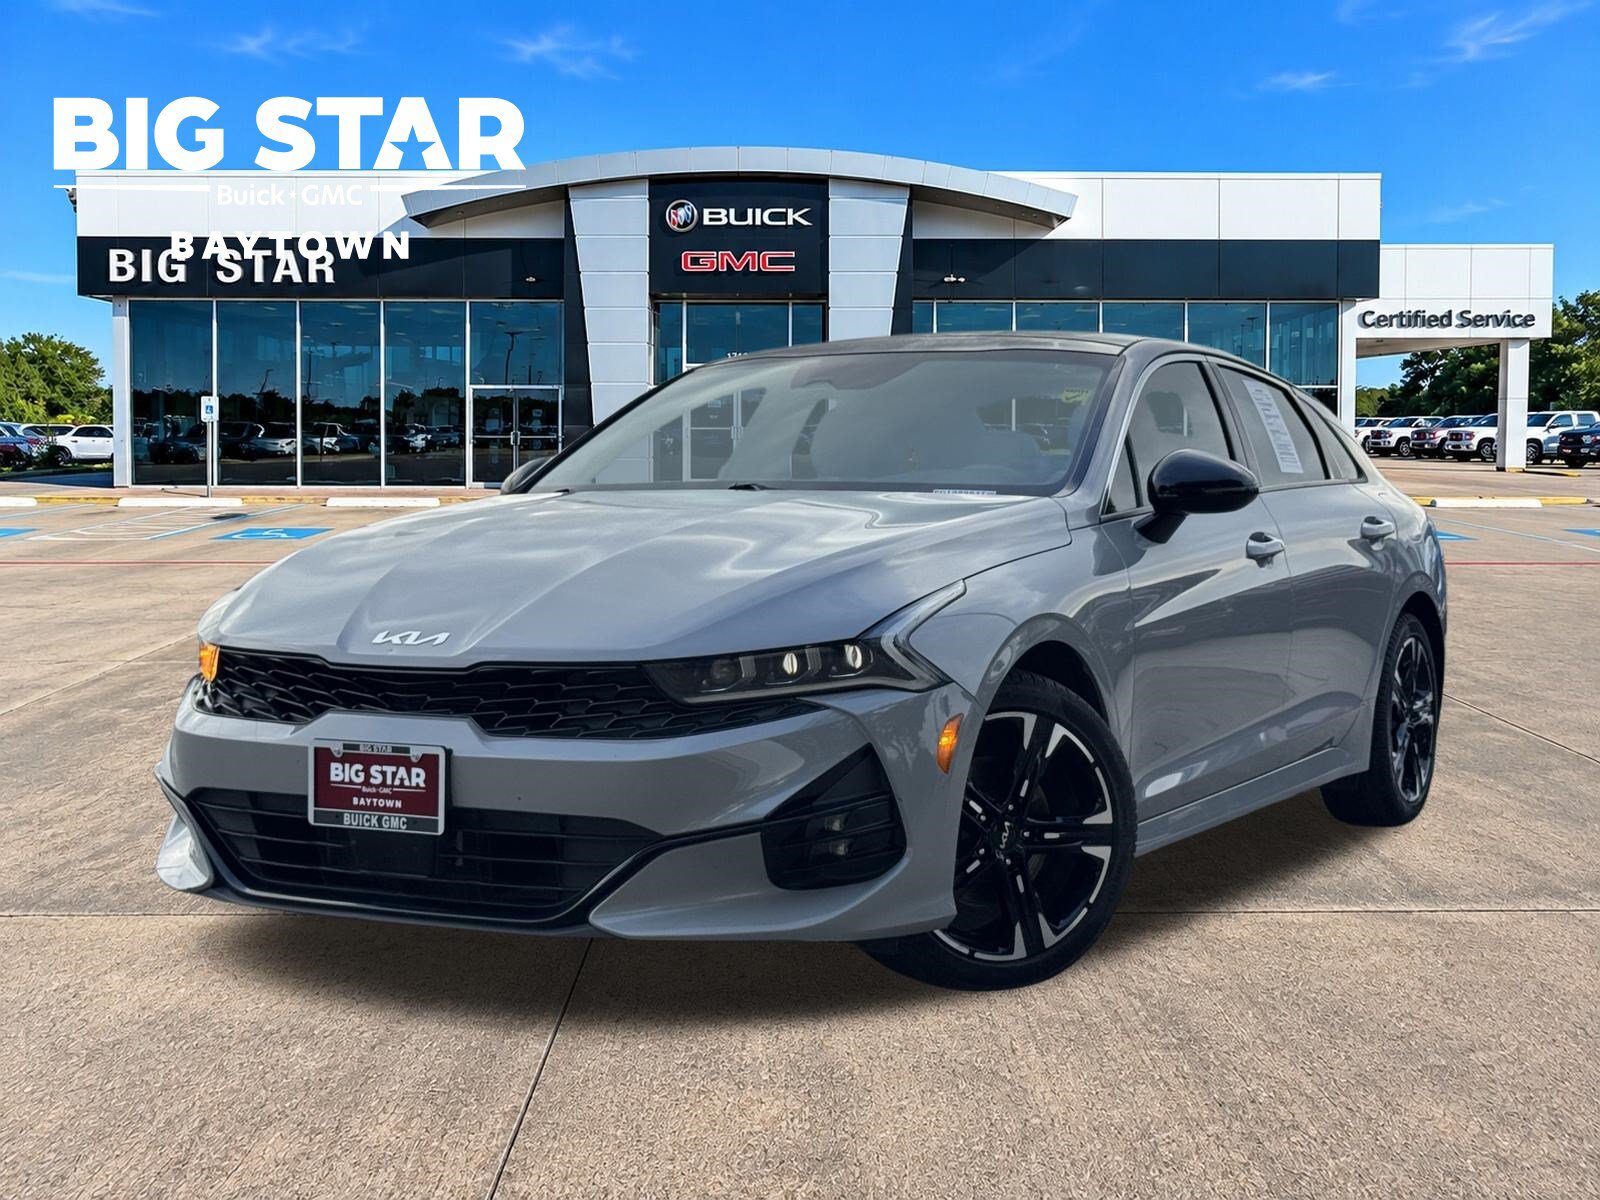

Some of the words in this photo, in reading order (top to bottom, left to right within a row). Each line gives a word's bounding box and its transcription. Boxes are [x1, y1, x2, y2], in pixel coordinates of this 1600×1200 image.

[702, 207, 813, 226] BUICK
[108, 247, 187, 283] BIG
[215, 247, 336, 283] STAR
[681, 251, 796, 272] GMC
[1360, 309, 1452, 328] Certified
[1459, 309, 1536, 328] Service
[372, 630, 451, 646] KIA
[373, 744, 393, 753] STAR
[330, 762, 365, 784] BIG
[370, 764, 426, 787] STAR
[352, 796, 402, 808] BAYTOWN
[343, 812, 379, 828] BUICK
[382, 814, 408, 830] GMC
